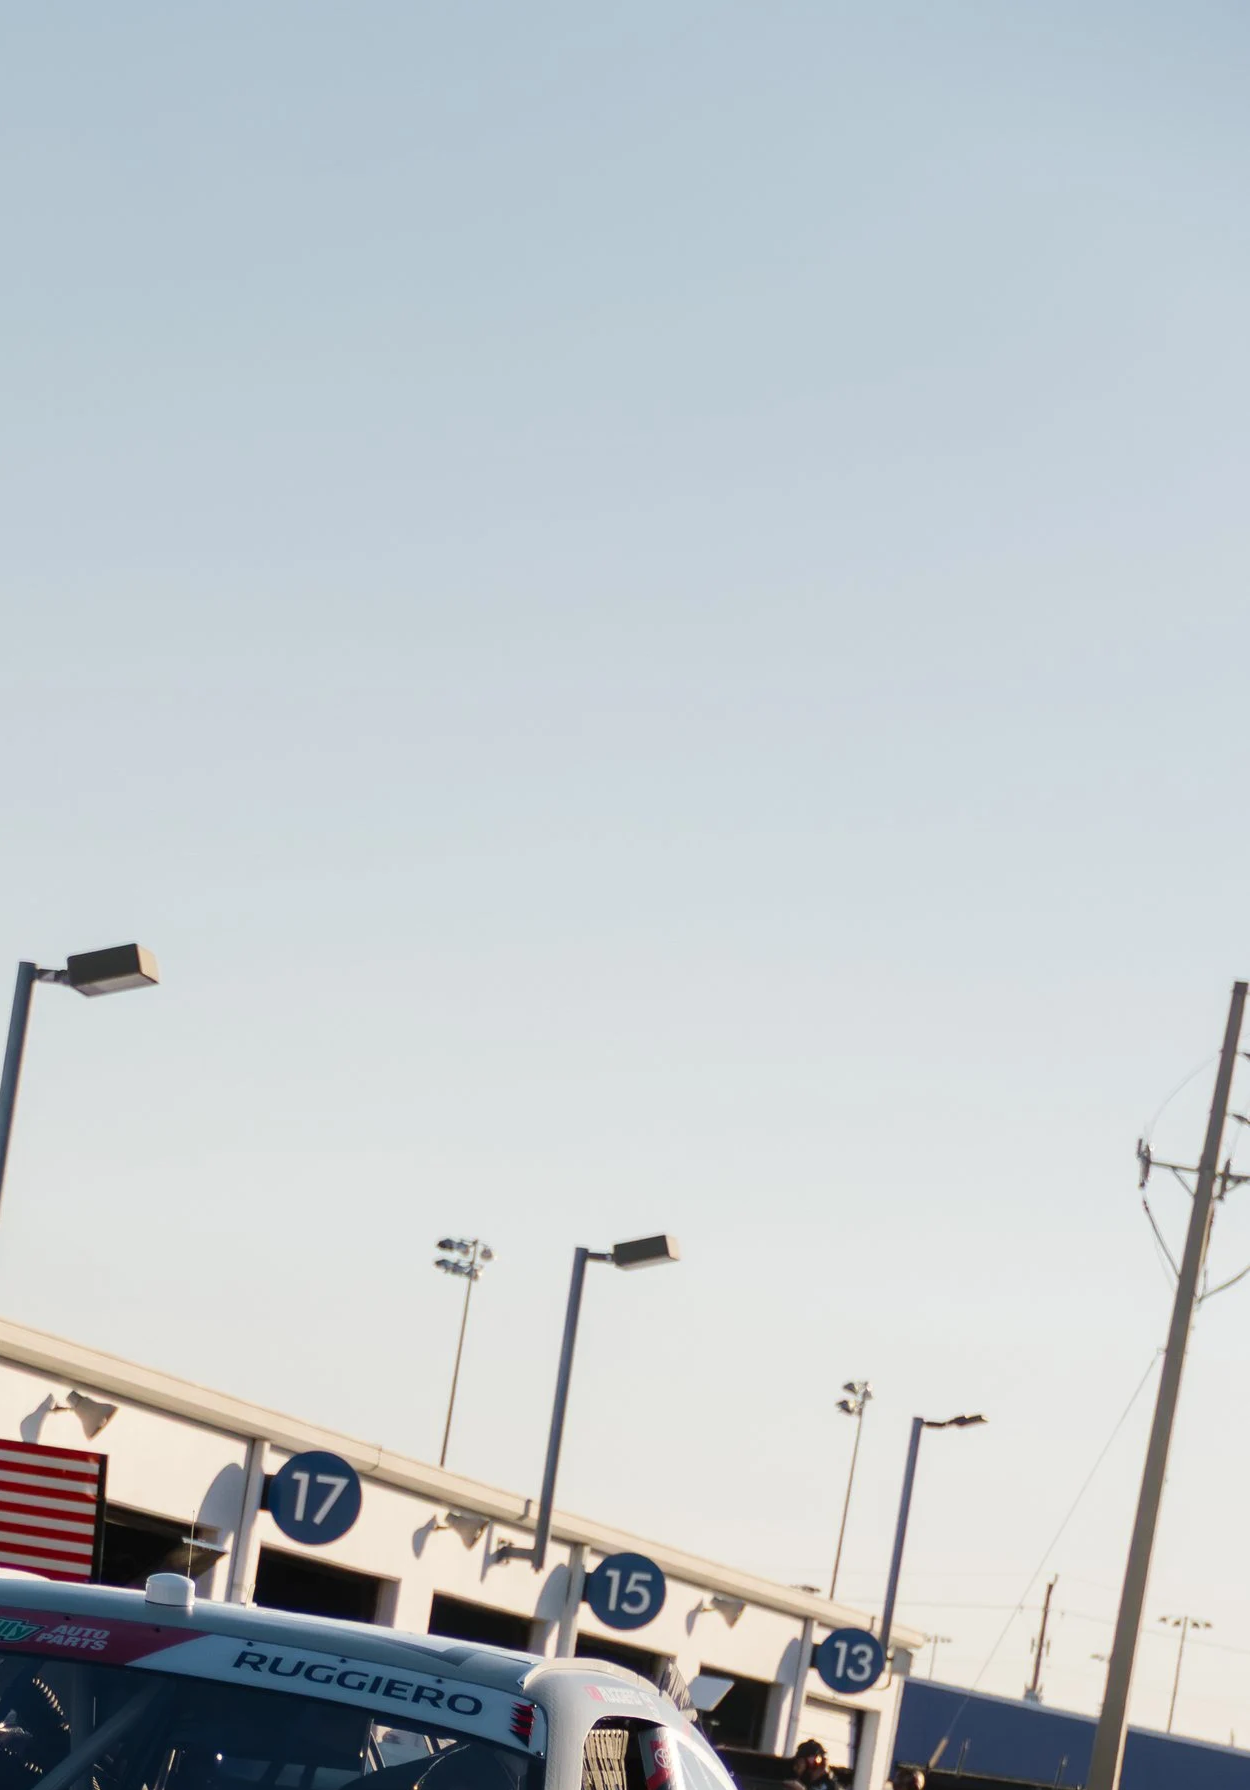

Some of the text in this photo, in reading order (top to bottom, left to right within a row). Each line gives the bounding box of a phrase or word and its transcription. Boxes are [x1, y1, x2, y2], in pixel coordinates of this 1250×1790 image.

[292, 1471, 349, 1525] 17
[606, 1569, 652, 1614] 15
[35, 1632, 108, 1651] PARTS
[50, 1625, 111, 1641] AUTO
[231, 1647, 484, 1718] RUGGIERO
[836, 1641, 873, 1682] 13
